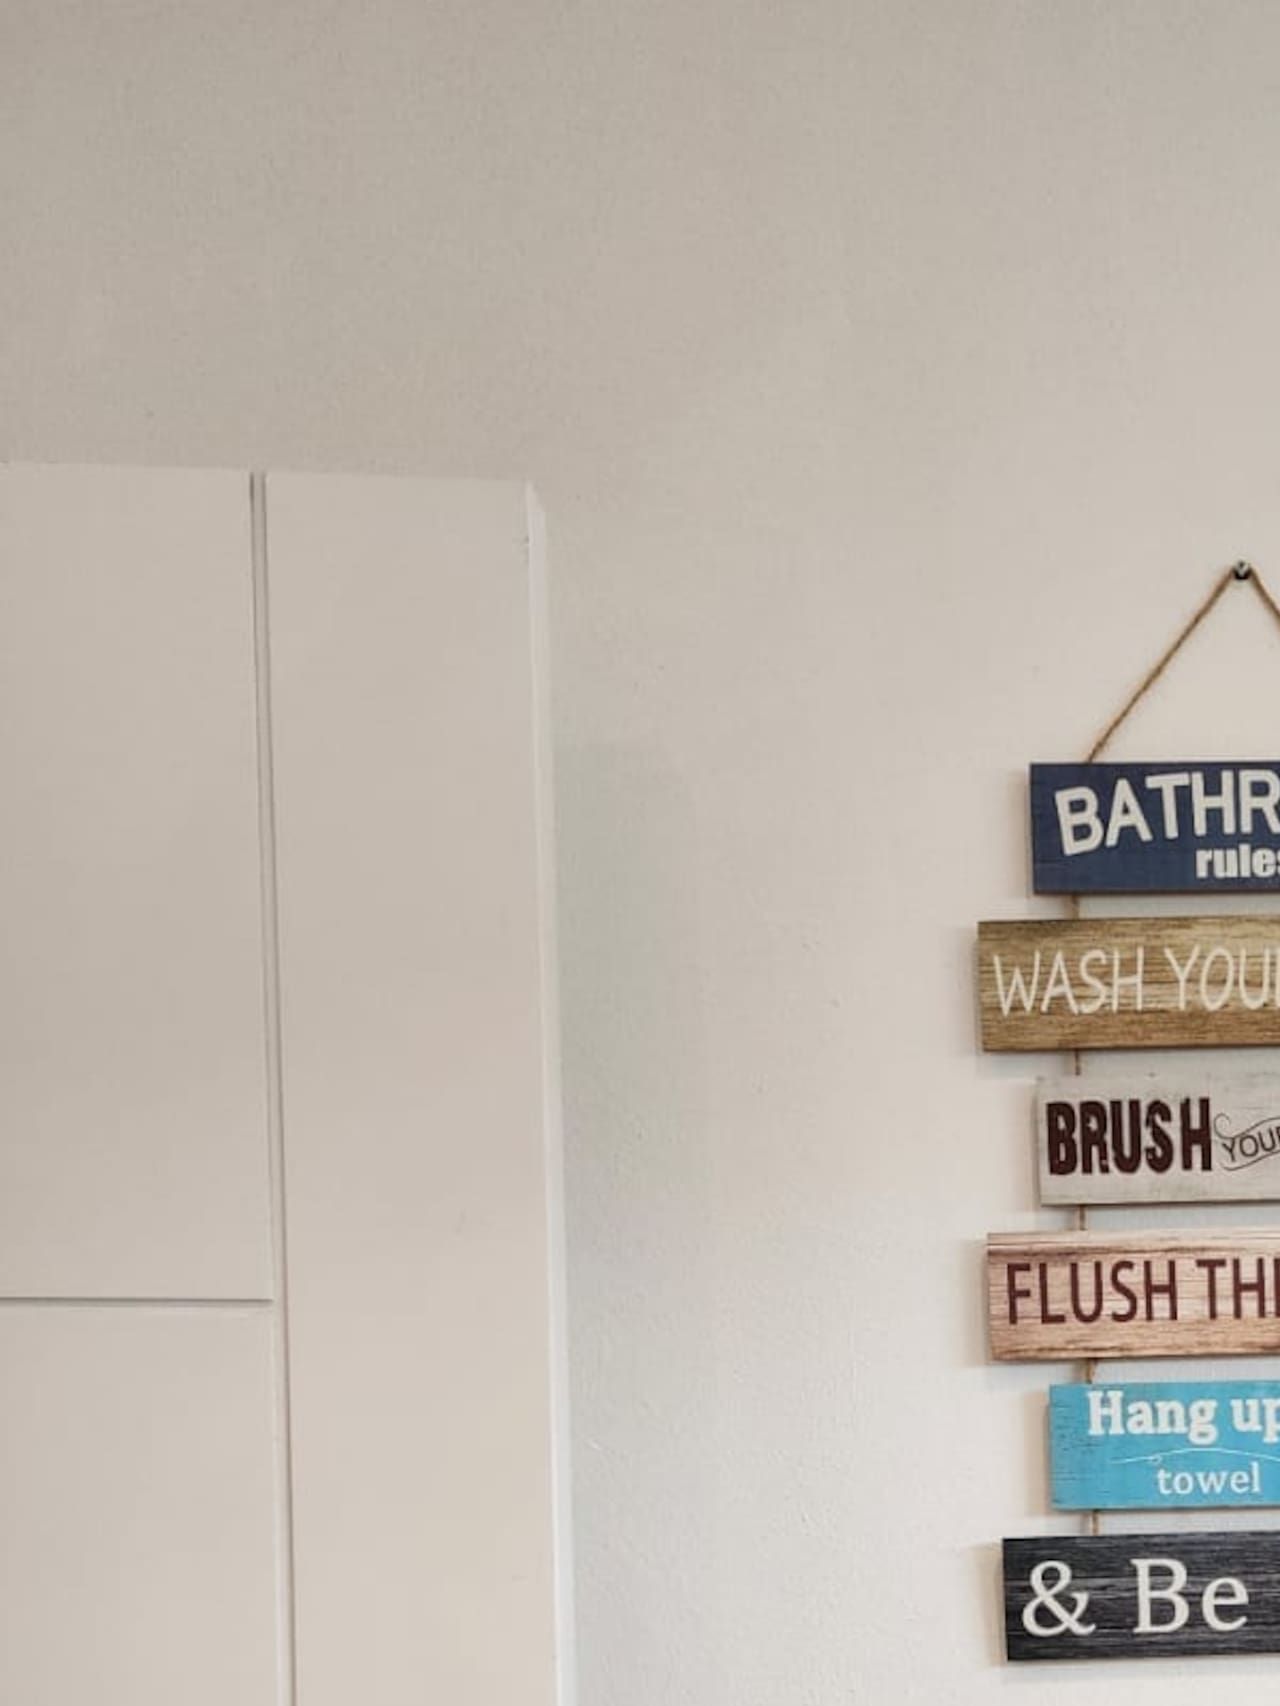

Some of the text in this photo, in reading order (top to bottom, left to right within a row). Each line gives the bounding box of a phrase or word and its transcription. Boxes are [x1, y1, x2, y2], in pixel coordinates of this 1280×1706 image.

[993, 946, 1144, 1017] WASH
[1046, 1096, 1213, 1176] BRUSH
[1006, 1259, 1179, 1325] FLUSH
[1086, 1389, 1218, 1444] Hang
[1157, 1462, 1262, 1495] towel
[1021, 1560, 1096, 1637] &
[1131, 1557, 1250, 1635] Be
